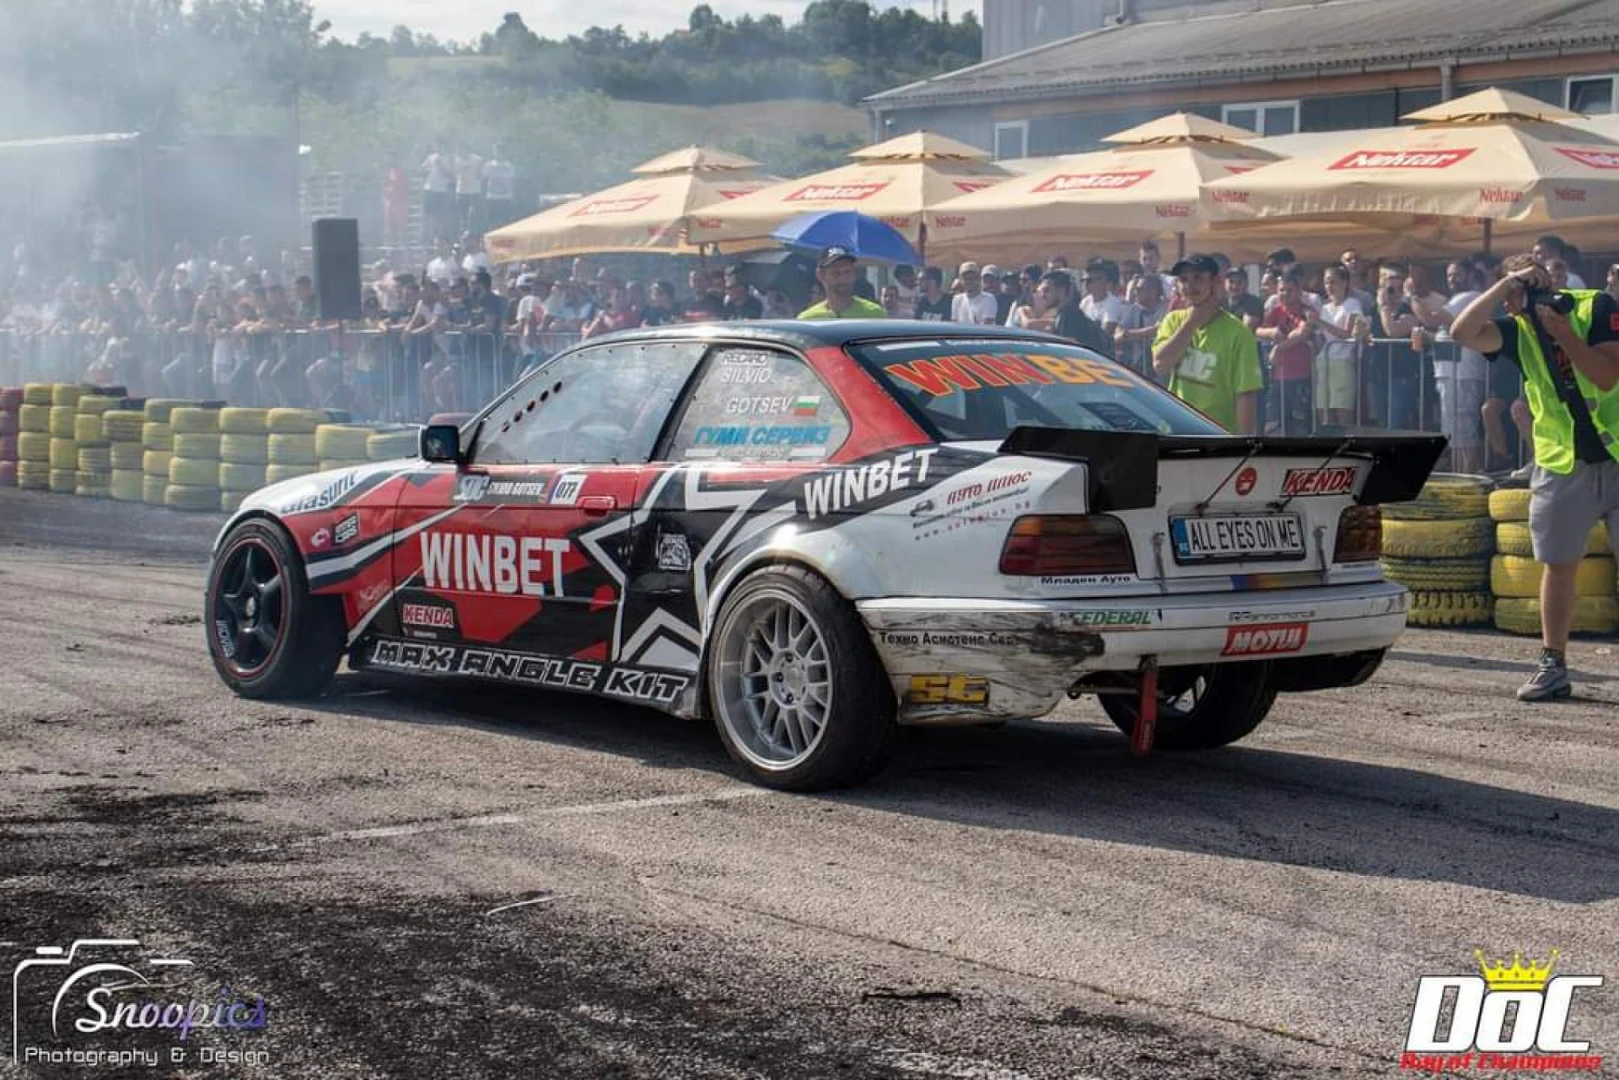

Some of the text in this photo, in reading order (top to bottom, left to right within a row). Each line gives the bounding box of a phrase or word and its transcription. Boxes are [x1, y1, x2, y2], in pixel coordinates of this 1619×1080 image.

[1343, 153, 1459, 168] Nektar
[1045, 172, 1141, 191] Nektar
[721, 367, 772, 384] SILVIO
[884, 353, 1134, 397] WINBE
[726, 394, 794, 415] GOTSEV
[695, 426, 748, 445] ГУМИ
[555, 481, 578, 499] 077
[804, 448, 939, 521] WINBET
[1191, 520, 1300, 551] ALL EYES ON ME
[420, 531, 571, 598] WINBET
[1101, 575, 1131, 585] Ауто
[403, 604, 454, 628] KENDA
[1228, 626, 1302, 654] MOTUL
[370, 640, 688, 702] MAX ANGLE KIT
